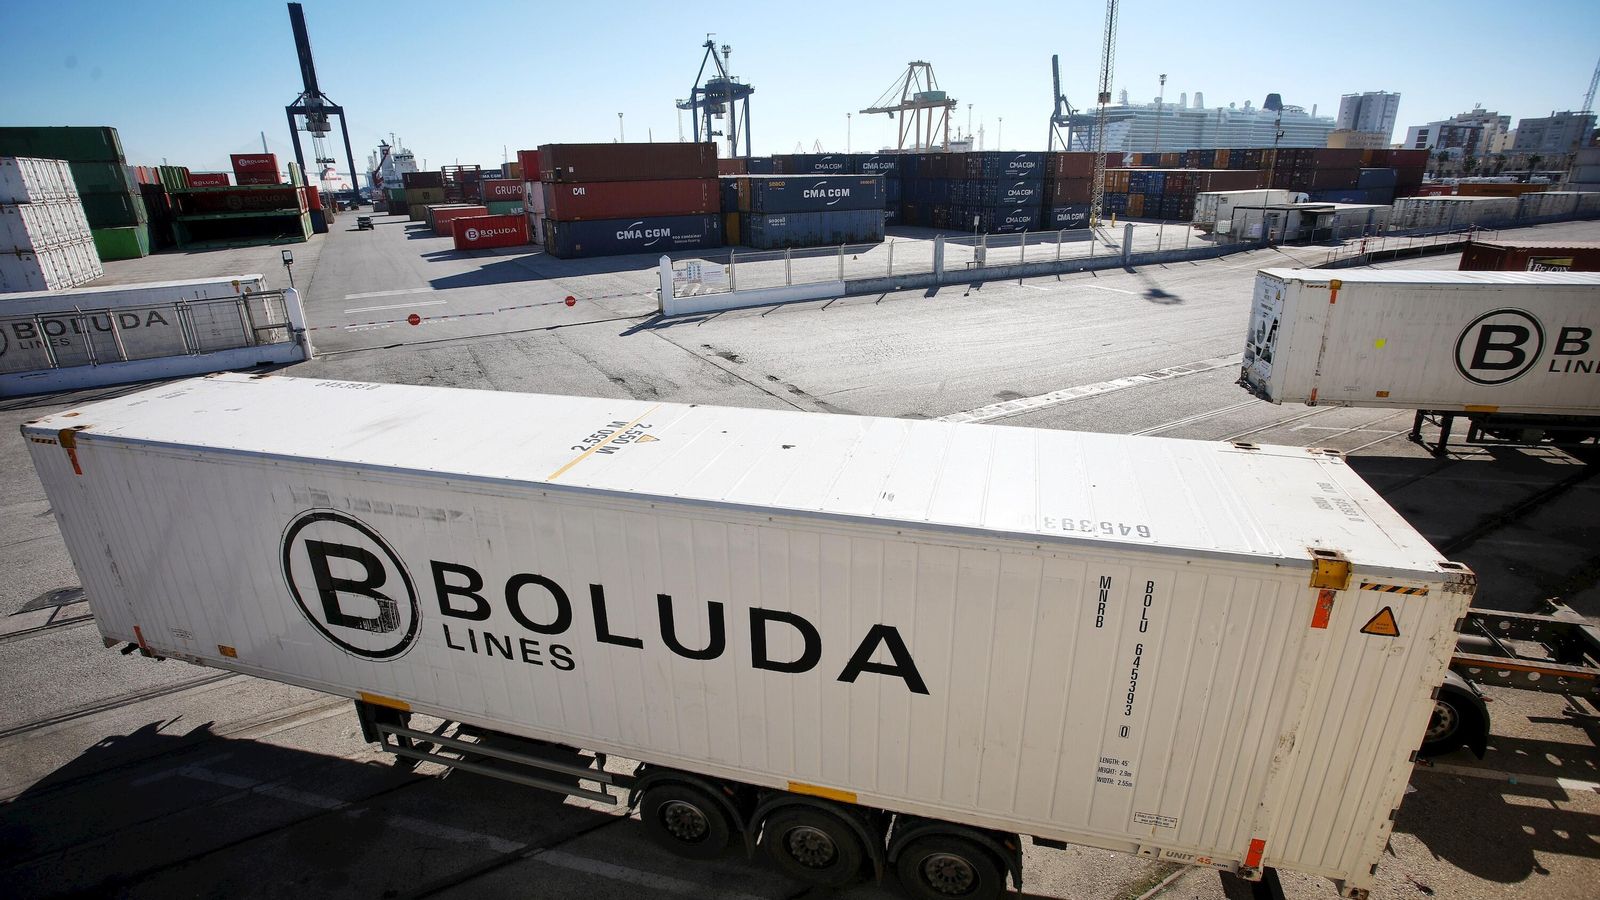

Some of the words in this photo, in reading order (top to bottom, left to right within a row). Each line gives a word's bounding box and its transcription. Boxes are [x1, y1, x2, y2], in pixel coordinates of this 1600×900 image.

[863, 162, 878, 170] CMA
[495, 186, 523, 195] GRUPO
[803, 189, 826, 198] CMA
[828, 188, 850, 197] CGM
[1057, 213, 1070, 221] CMA
[1071, 212, 1084, 220] CGM
[480, 227, 517, 236] BOLUDA
[616, 229, 643, 240] CMA
[645, 228, 671, 238] CGM
[11, 310, 169, 340] BOLUDA
[19, 337, 71, 350] LINES
[1470, 324, 1530, 370] B
[571, 429, 616, 452] 2.550
[606, 420, 629, 429] M
[611, 423, 653, 444] 2.550
[595, 445, 620, 454] M
[1043, 516, 1152, 538] 645393
[1095, 575, 1112, 628] MNRB
[1139, 580, 1154, 633] BOLU
[304, 538, 402, 635] B
[429, 559, 930, 695] BOLUDA
[442, 623, 576, 671] LINES
[1124, 643, 1143, 716] 645393
[1099, 757, 1120, 766] LENGTH:
[1097, 767, 1117, 776] HEIGHT:
[1119, 769, 1132, 778] 2.9m
[1096, 776, 1115, 785] WIDTH:
[1117, 779, 1133, 788] 2.55m
